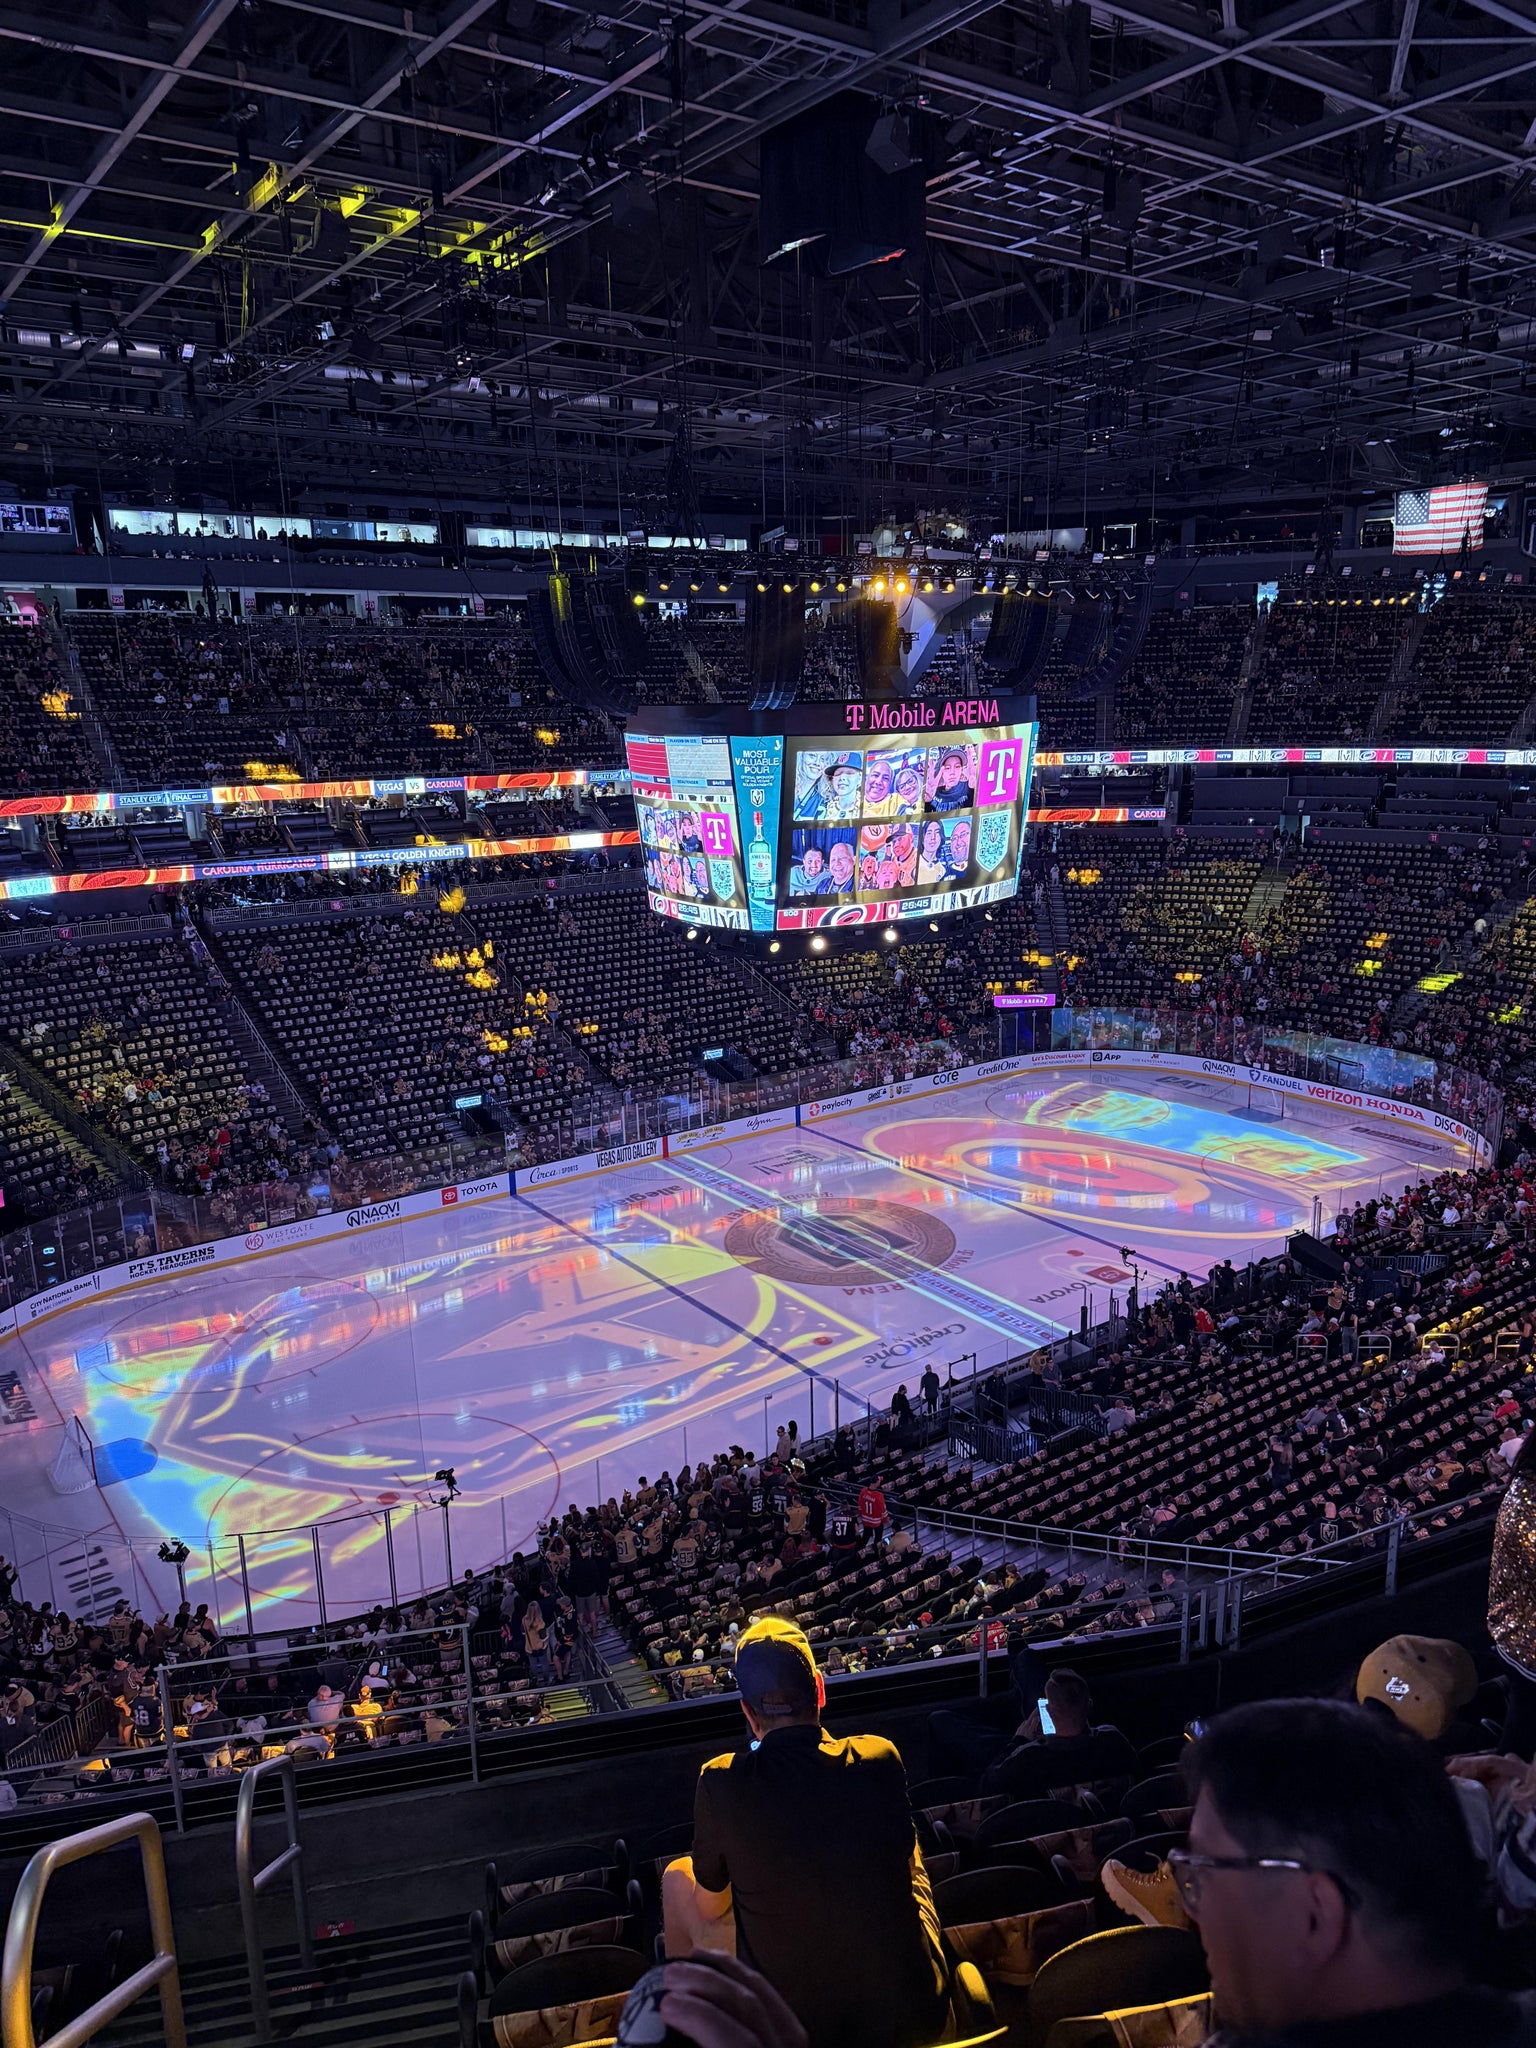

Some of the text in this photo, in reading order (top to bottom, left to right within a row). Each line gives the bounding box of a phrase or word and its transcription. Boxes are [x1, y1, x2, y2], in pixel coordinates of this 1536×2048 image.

[869, 702, 936, 729] Mobile
[941, 700, 1000, 725] ARENA
[735, 757, 779, 766] VALUABLE
[743, 750, 768, 758] MOST
[744, 766, 770, 774] POUR
[376, 782, 404, 791] VEGAS
[409, 782, 420, 790] VS
[425, 780, 463, 789] CAROLINA
[120, 796, 148, 804] STANLEY
[172, 794, 191, 802] FINAL
[360, 847, 465, 863] VEGAS GOLDEN KNIGHTS
[202, 858, 317, 876] CAROLINA HURRICANES
[1104, 1053, 1121, 1061] App
[1211, 1062, 1236, 1074] NAQVI
[932, 1071, 959, 1085] core
[1155, 1076, 1206, 1089] CAT
[1262, 1074, 1303, 1091] FANDUEL
[1306, 1085, 1363, 1107] verizon
[821, 1097, 852, 1112] paylocity
[1366, 1098, 1425, 1121] HONDA
[1434, 1115, 1476, 1143] DISCOVER
[596, 1140, 657, 1168] VEGAS AUTO GALLERY
[529, 1167, 556, 1184] Circa
[461, 1181, 498, 1197] TOYOTA
[361, 1201, 400, 1220] NAQVI
[266, 1223, 315, 1240] WESTGATE
[129, 1246, 215, 1274] PT'S TAVERNS
[130, 1254, 215, 1279] HOCKEY HEADQUARTERS
[1028, 1279, 1096, 1304] TOYOTA
[862, 1324, 967, 1365] CreditOne
[752, 1500, 763, 1513] 93
[775, 1500, 787, 1512] 71
[865, 1501, 873, 1515] 11
[835, 1521, 848, 1536] 37
[57, 1631, 76, 1647] 93
